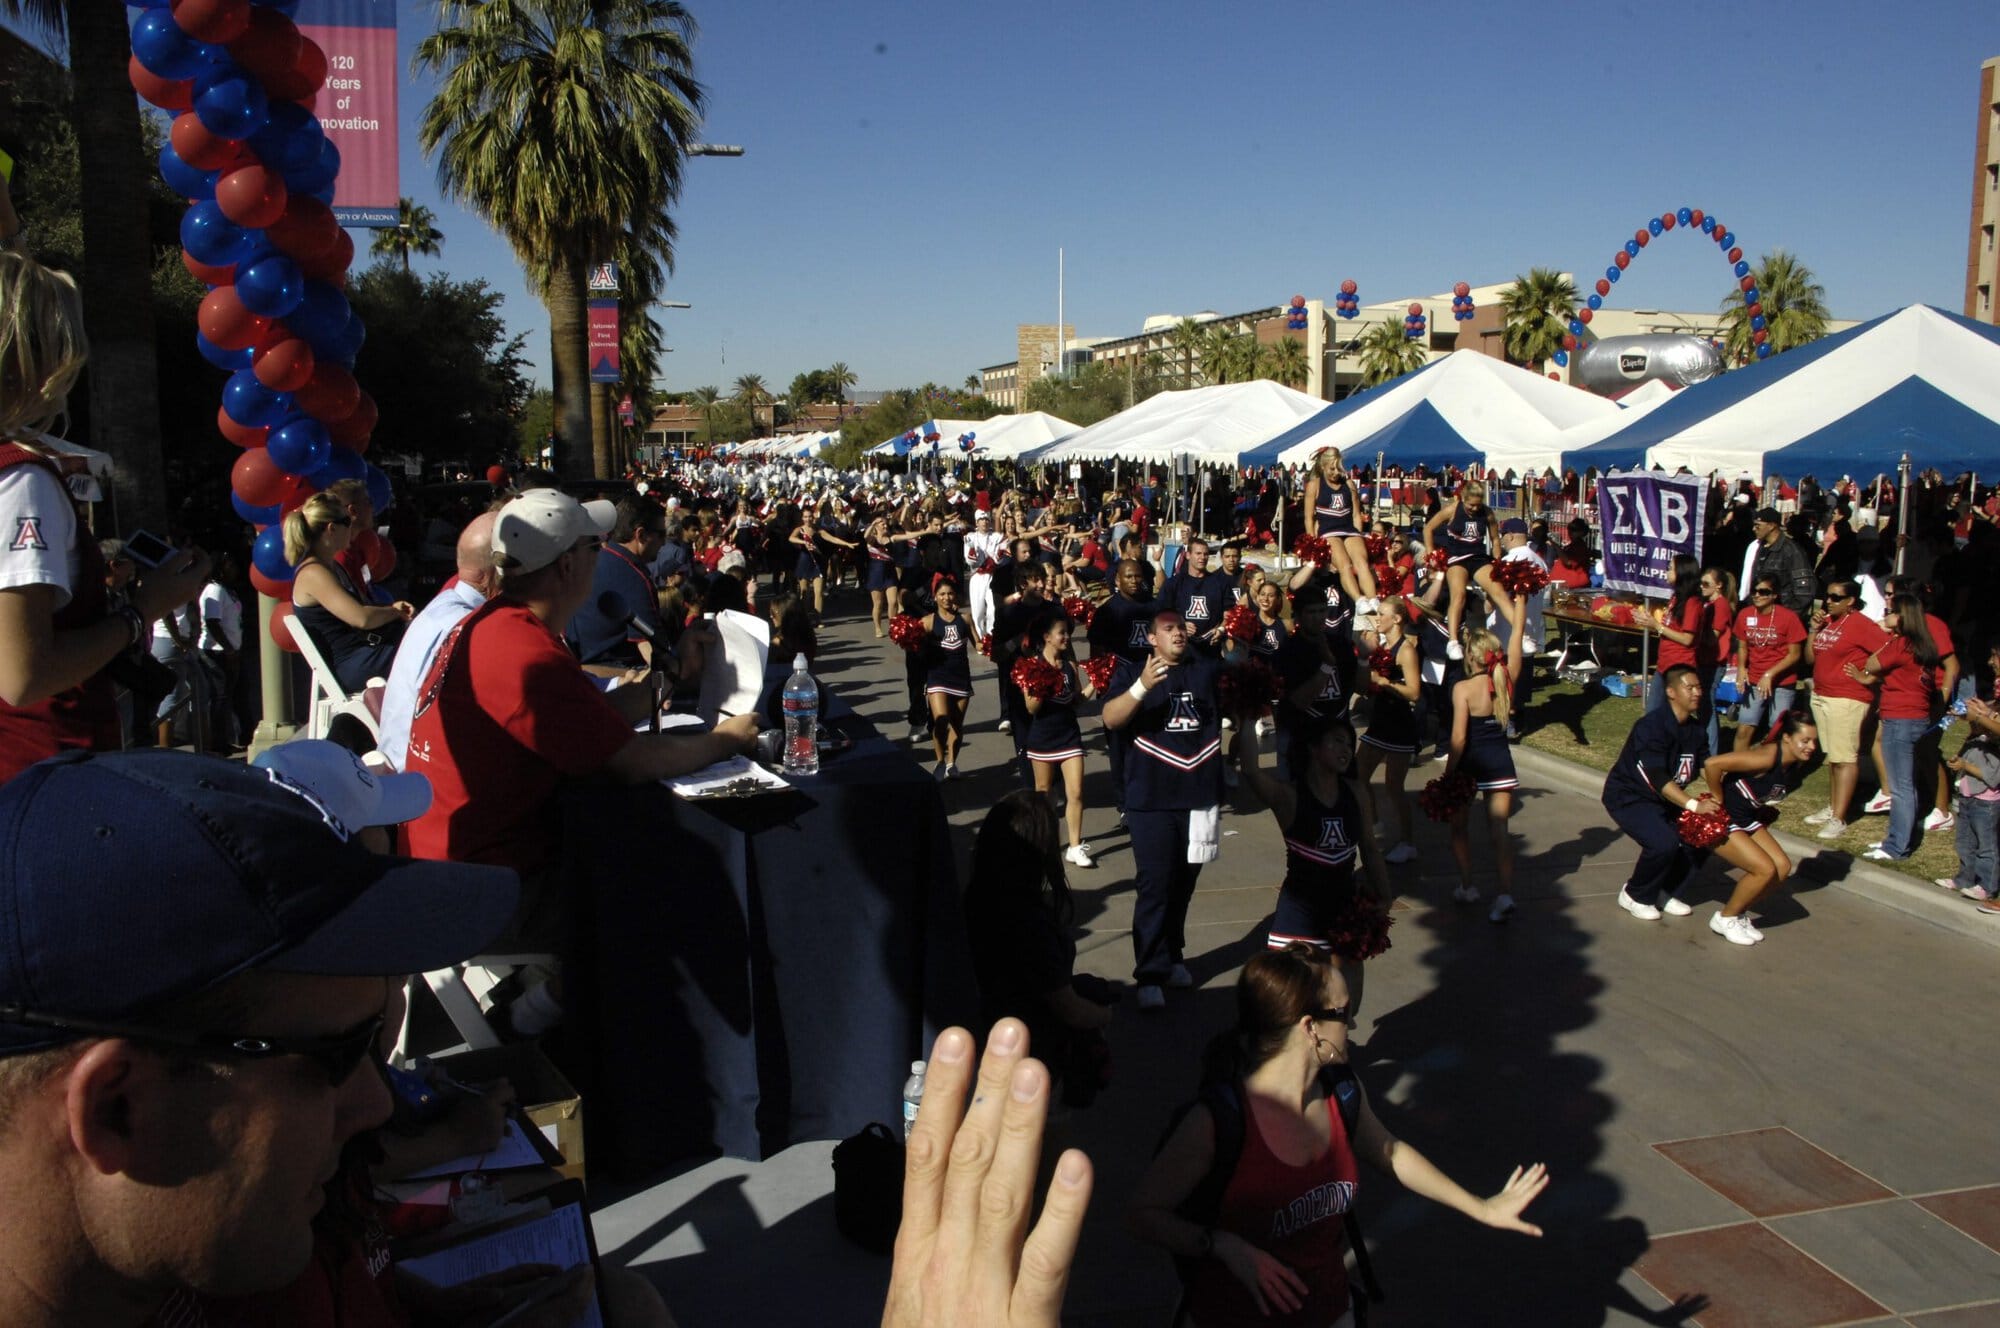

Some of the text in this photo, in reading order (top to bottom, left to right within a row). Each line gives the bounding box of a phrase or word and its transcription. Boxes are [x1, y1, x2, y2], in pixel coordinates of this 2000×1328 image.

[331, 56, 354, 70] 120
[325, 76, 361, 90] Years
[336, 96, 351, 110] of
[319, 117, 379, 131] novation
[590, 263, 618, 289] A
[10, 516, 48, 551] A
[1639, 565, 1668, 580] ALPH
[1186, 595, 1210, 620] A
[1164, 691, 1202, 732] A
[1315, 816, 1351, 850] A
